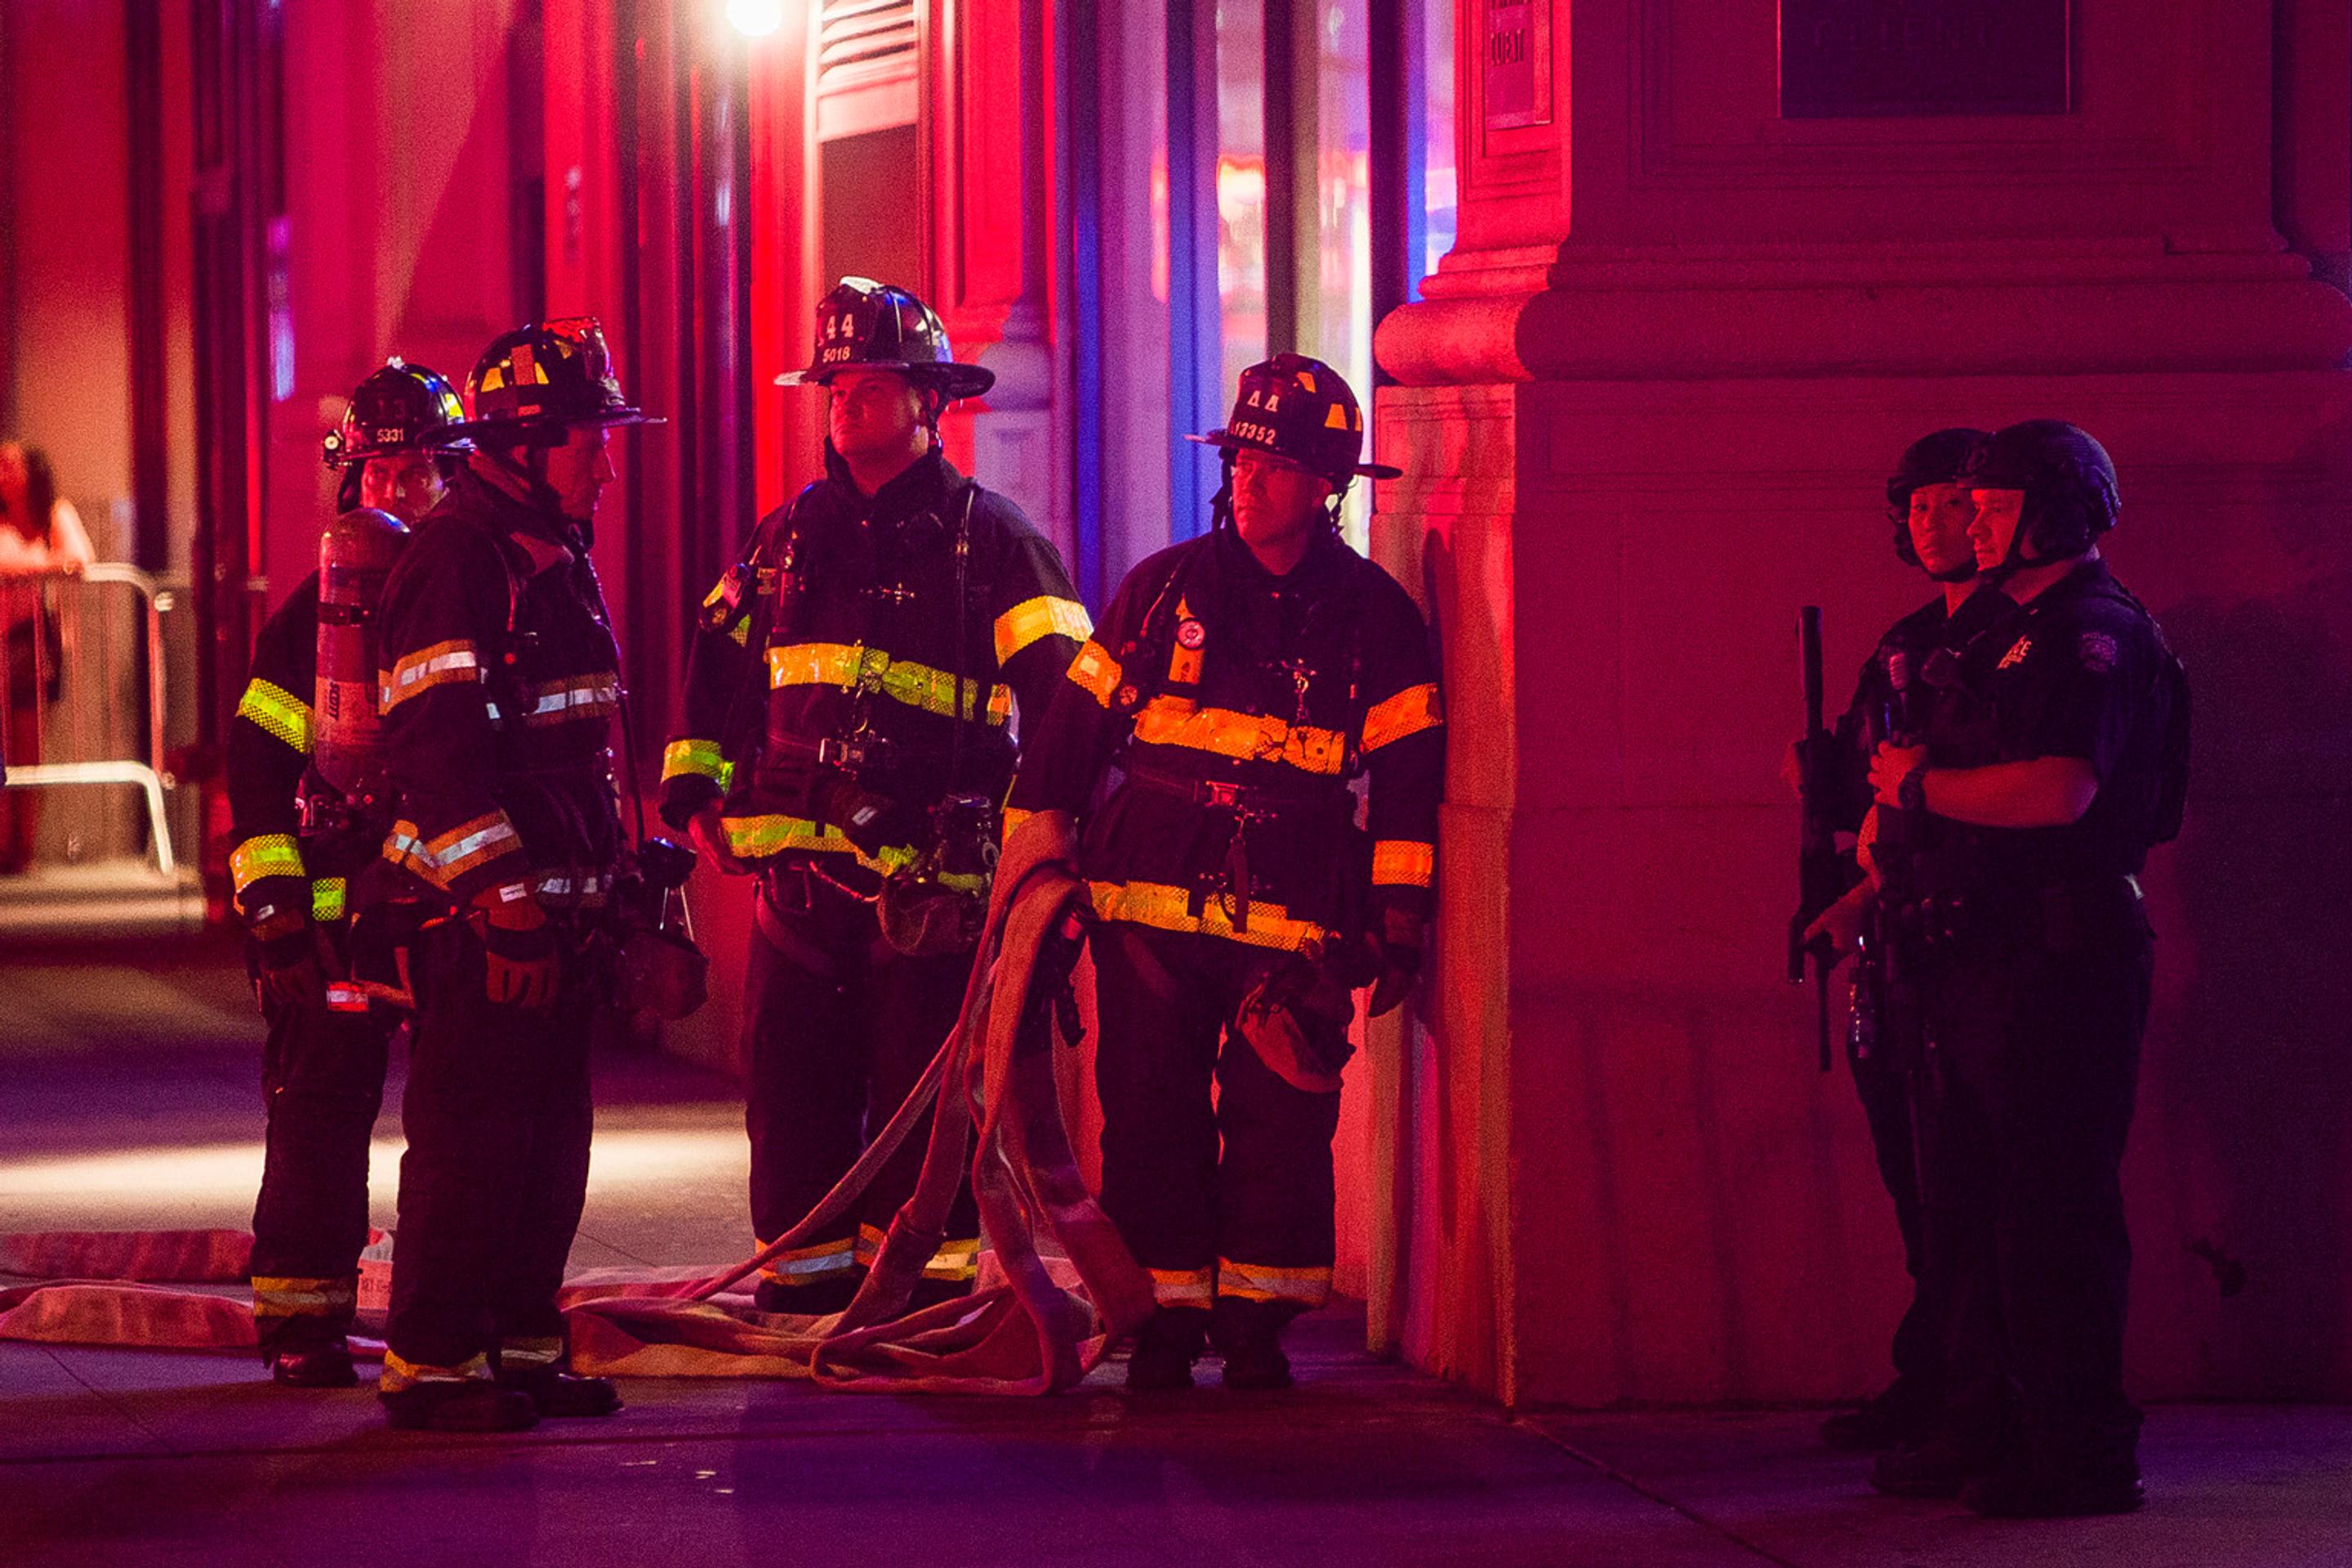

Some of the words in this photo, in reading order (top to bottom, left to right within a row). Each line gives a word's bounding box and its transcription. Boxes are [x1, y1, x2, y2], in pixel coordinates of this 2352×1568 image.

[826, 314, 854, 340] 44
[822, 345, 851, 363] 5018
[1247, 390, 1280, 413] 44
[376, 428, 404, 443] 5331
[1234, 421, 1276, 445] 13352
